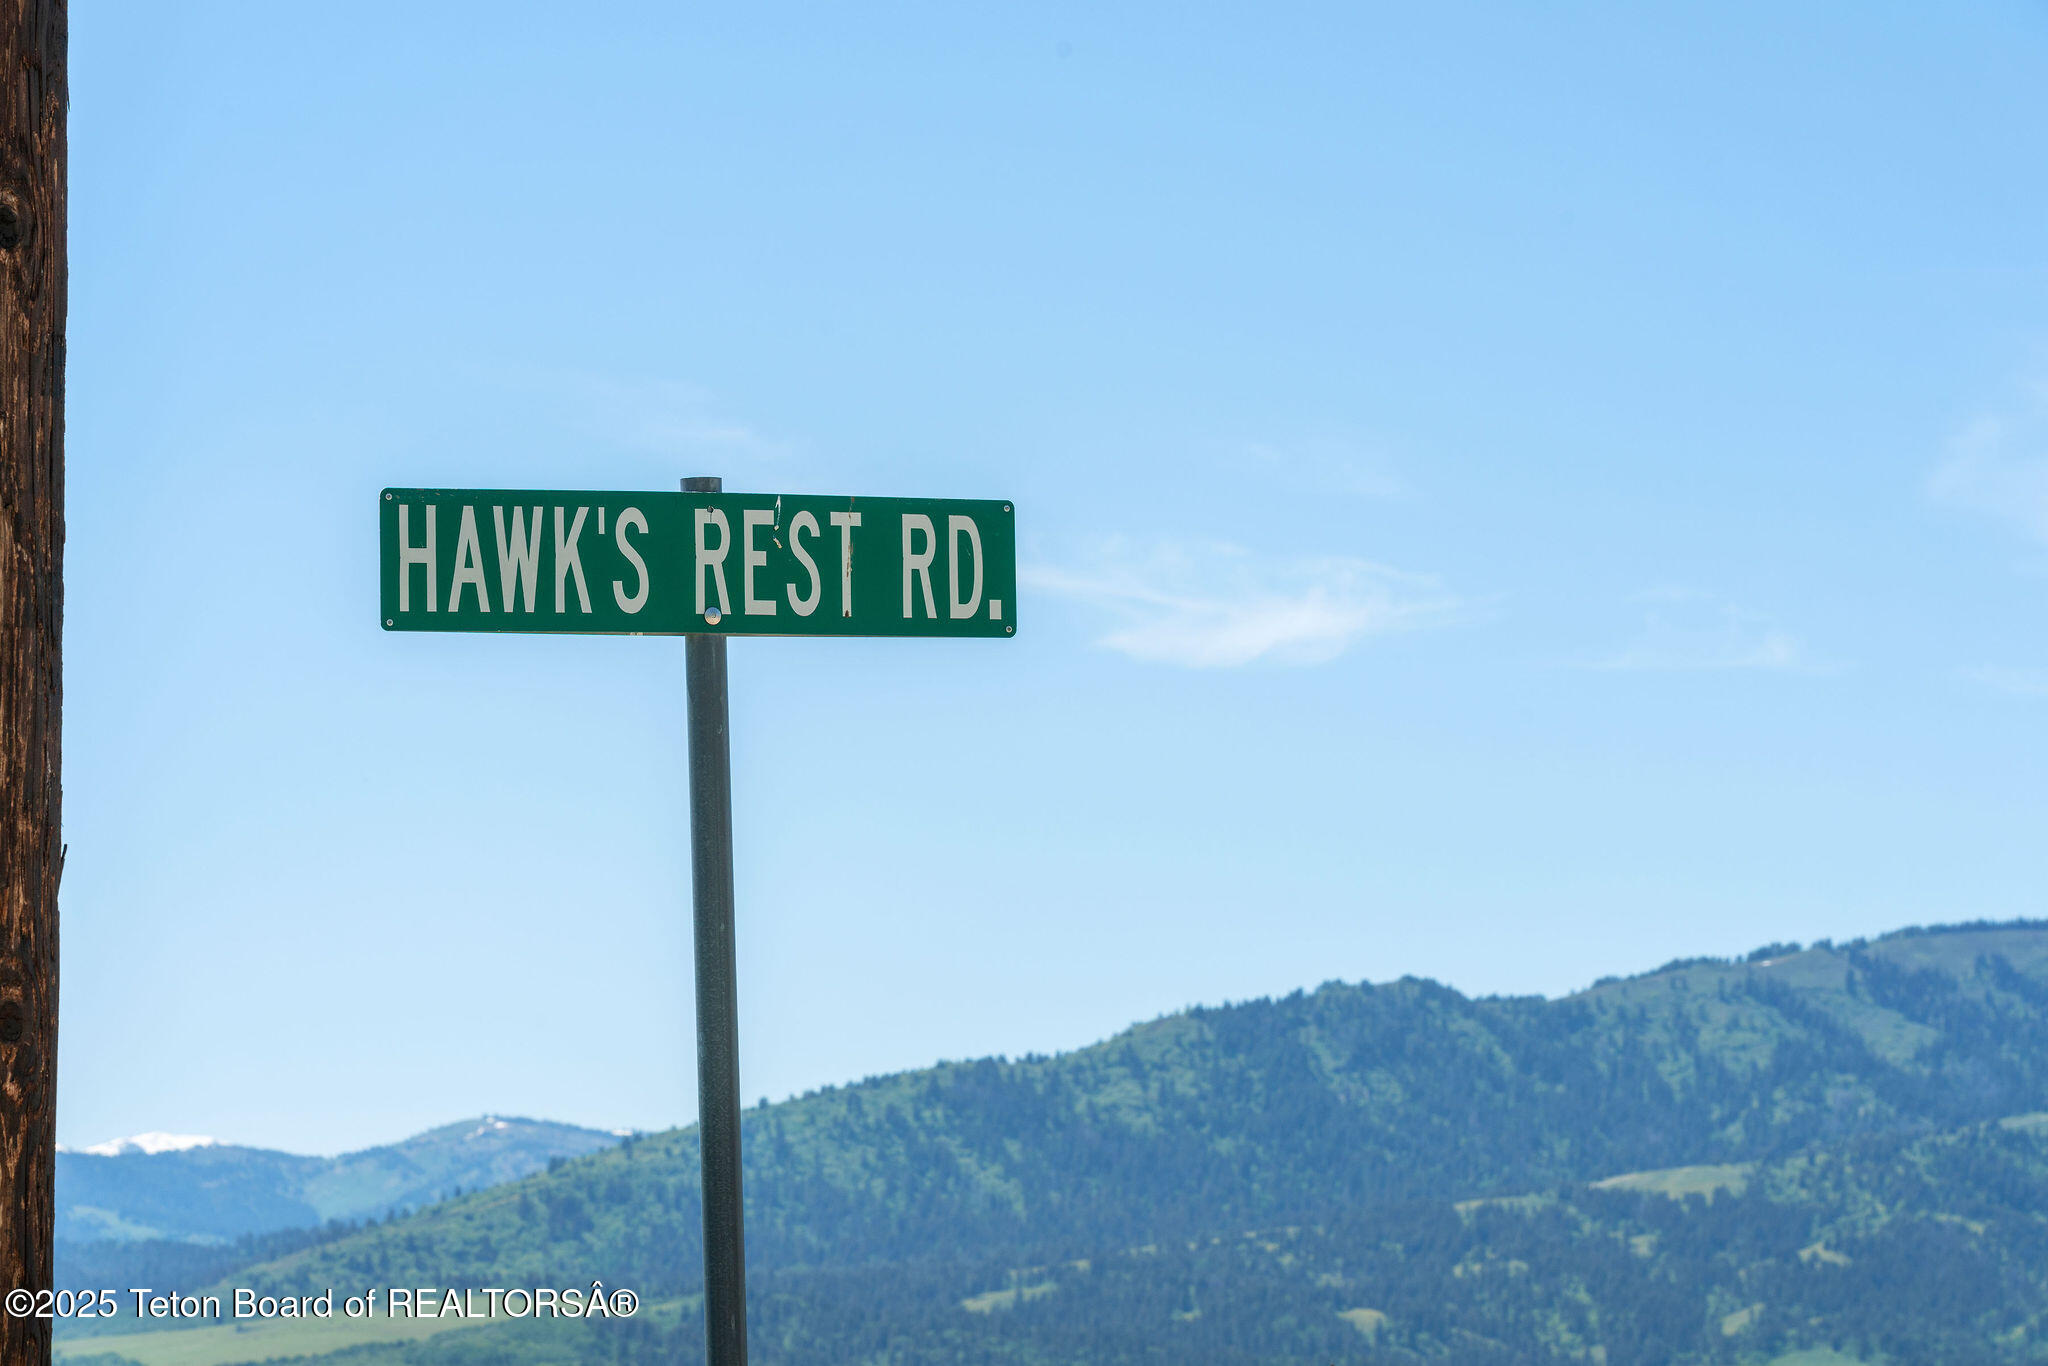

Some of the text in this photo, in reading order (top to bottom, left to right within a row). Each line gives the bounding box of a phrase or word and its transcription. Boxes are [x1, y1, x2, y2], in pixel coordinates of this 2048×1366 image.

[399, 504, 1002, 620] HAWK'S REST RD.
